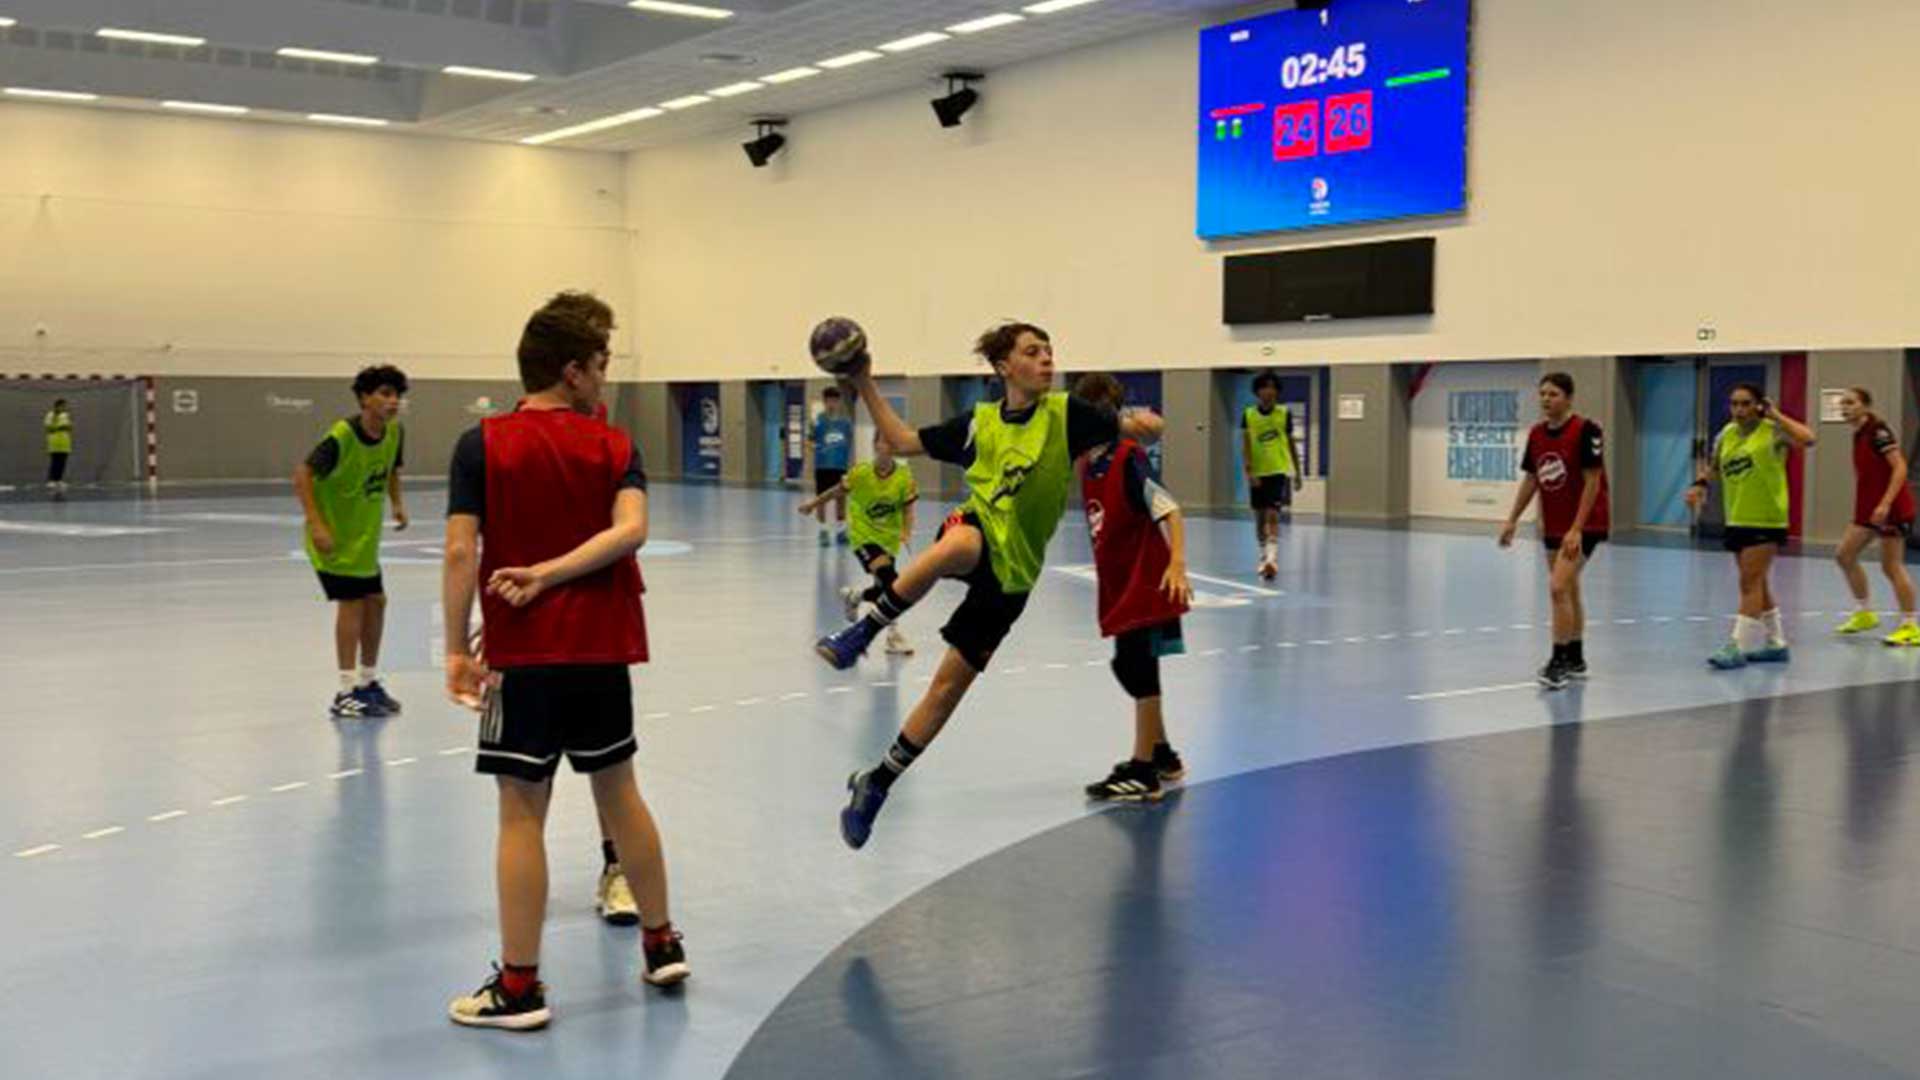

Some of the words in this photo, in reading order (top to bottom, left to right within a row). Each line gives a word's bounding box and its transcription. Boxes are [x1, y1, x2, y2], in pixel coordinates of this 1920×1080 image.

[1319, 9, 1328, 25] 1
[1281, 42, 1366, 89] 02:45
[1280, 113, 1313, 147] 24
[1331, 102, 1368, 137] 26
